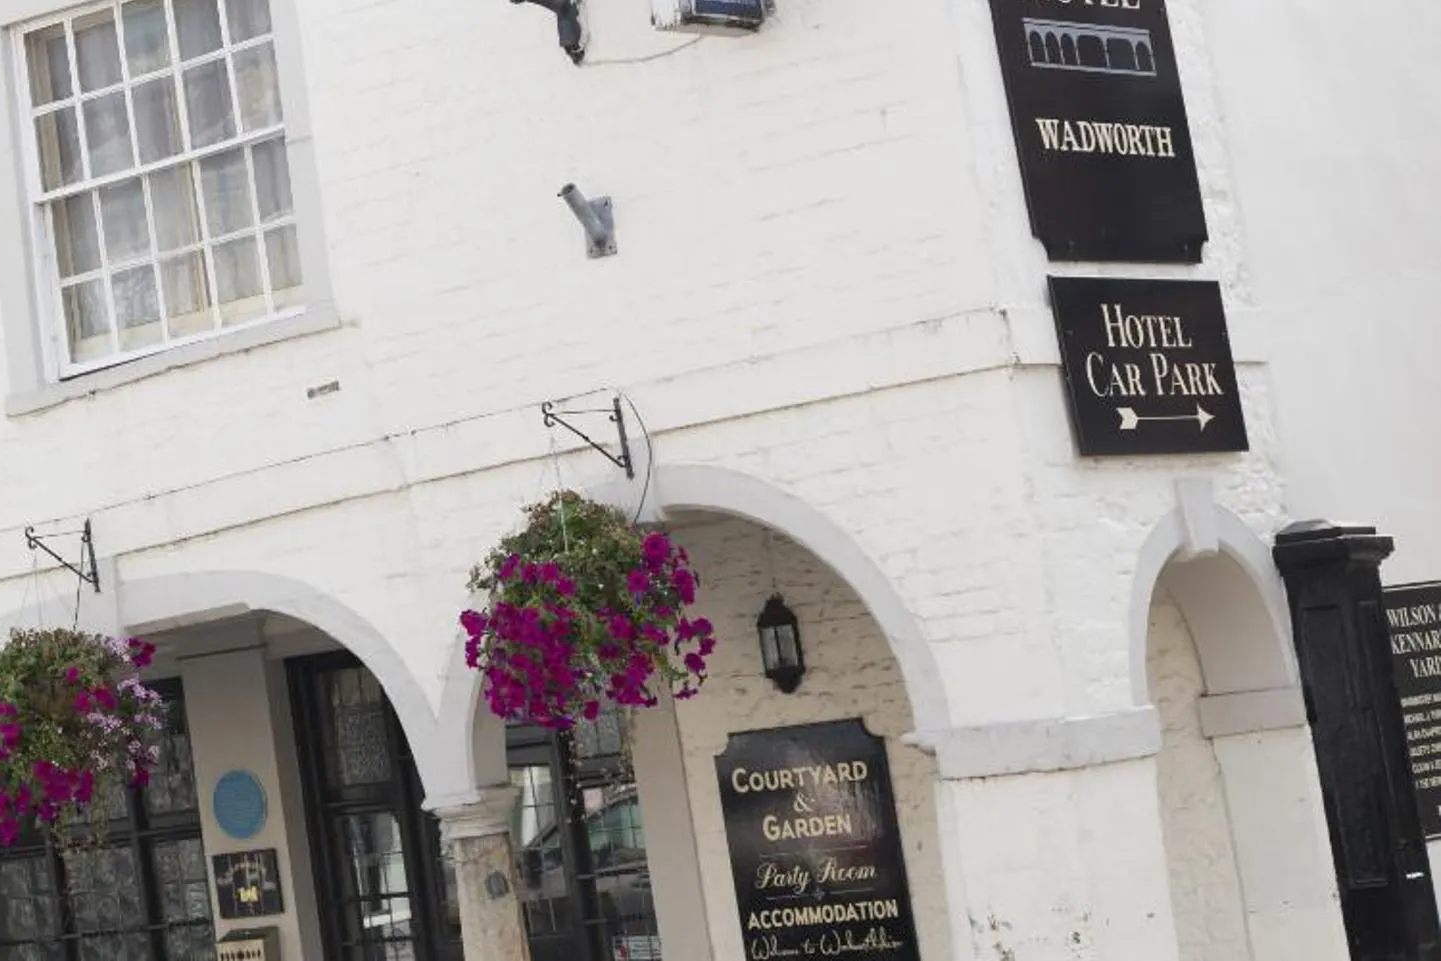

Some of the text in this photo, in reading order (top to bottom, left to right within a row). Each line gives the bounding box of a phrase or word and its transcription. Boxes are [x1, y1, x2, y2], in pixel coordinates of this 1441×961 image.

[1035, 117, 1176, 158] WADWORTH
[1101, 303, 1193, 349] HOTEL
[1086, 351, 1224, 397] CAR PARK
[1390, 630, 1441, 654] KENNAR
[732, 761, 868, 793] COURTYARD
[793, 792, 816, 813] &
[763, 813, 852, 841] GARDEN
[755, 856, 876, 894] Party Room
[748, 899, 899, 931] ACCOMMODATION
